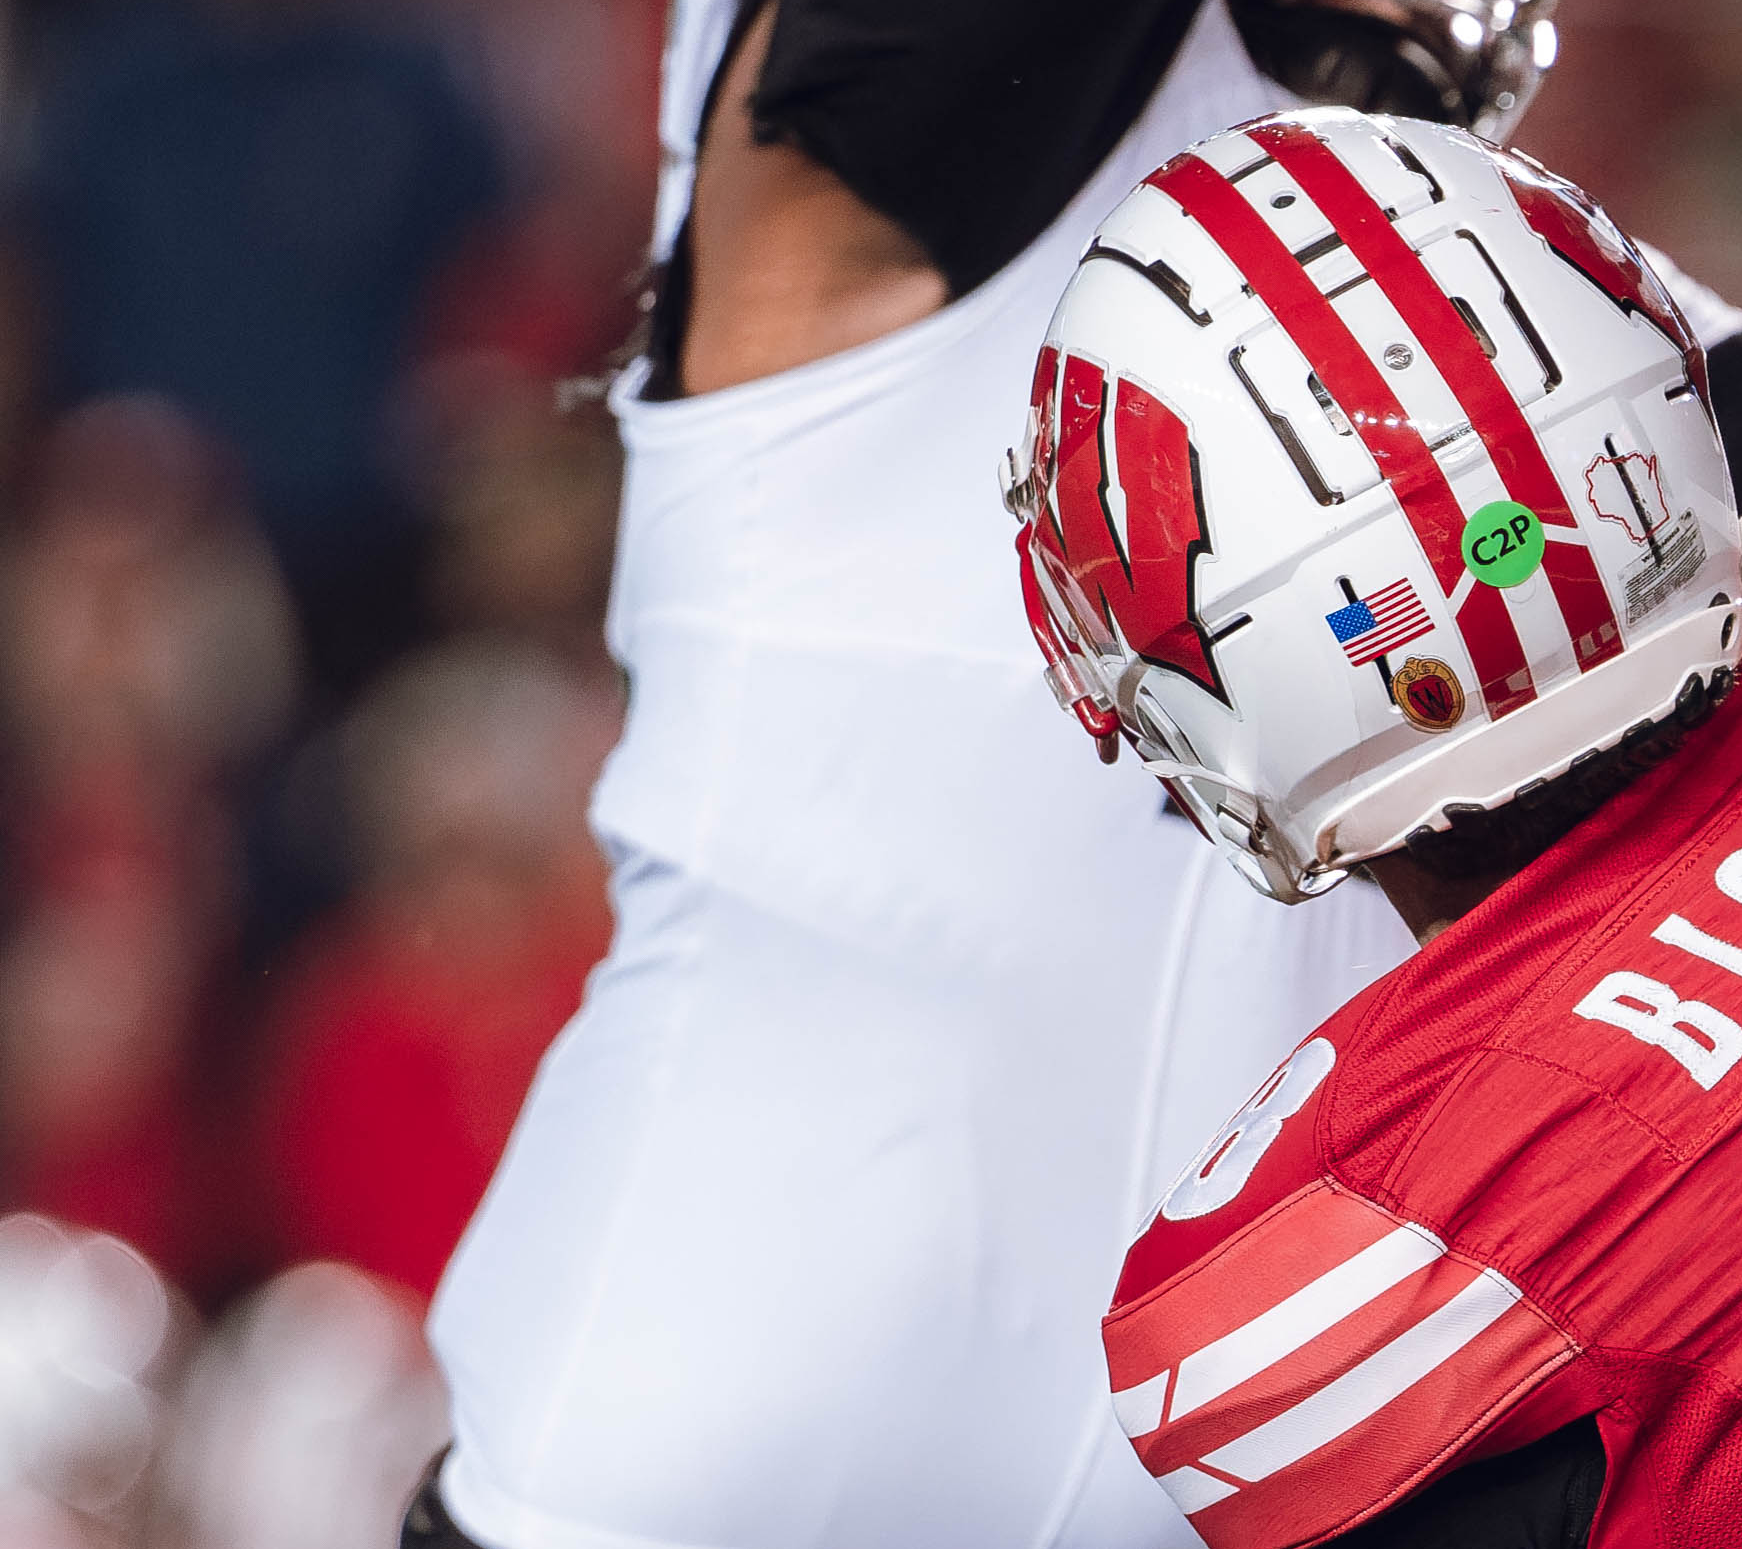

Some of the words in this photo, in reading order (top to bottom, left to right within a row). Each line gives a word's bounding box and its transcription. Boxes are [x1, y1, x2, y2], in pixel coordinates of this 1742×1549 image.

[1471, 514, 1530, 566] C2P
[1412, 681, 1448, 716] W
[1135, 1037, 1337, 1236] 8
